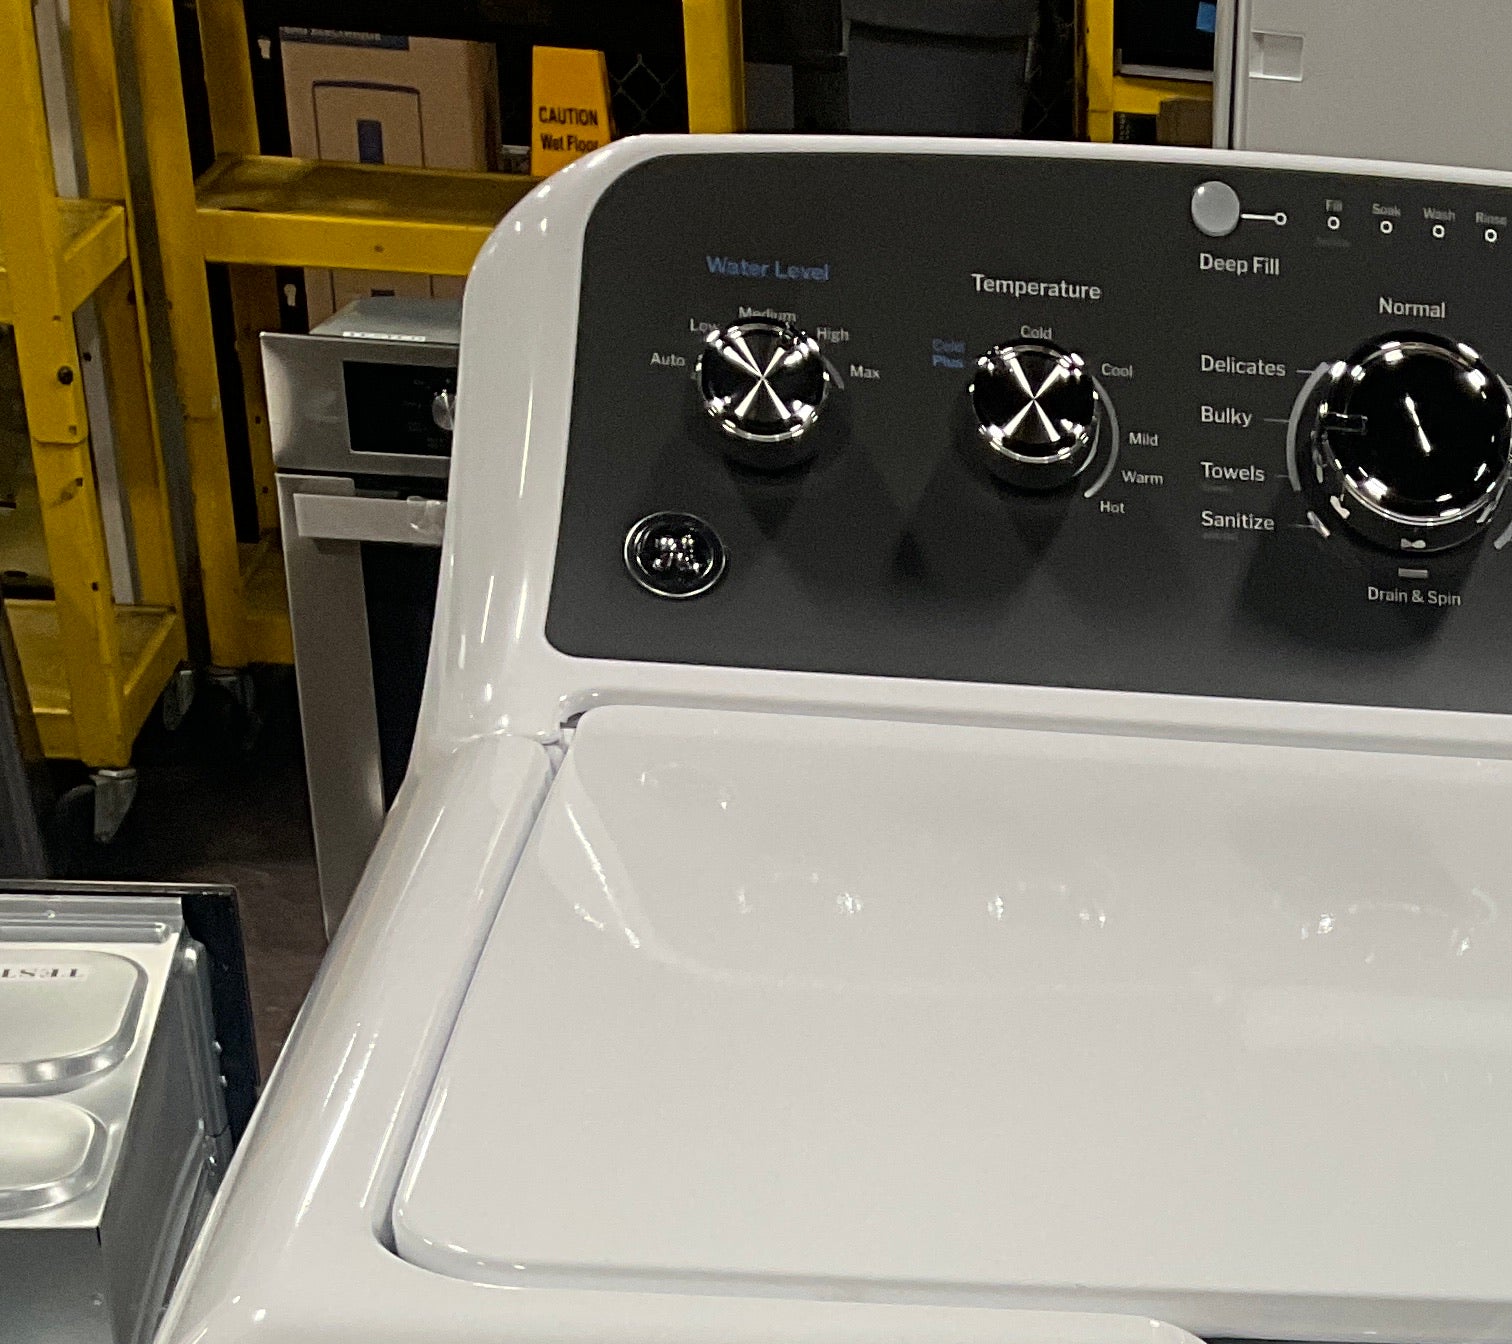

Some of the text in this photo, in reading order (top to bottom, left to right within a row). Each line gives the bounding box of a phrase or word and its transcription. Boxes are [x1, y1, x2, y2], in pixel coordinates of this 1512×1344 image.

[538, 106, 599, 126] CAUTION
[540, 133, 599, 152] Wet Floor
[1371, 203, 1401, 217] Soak
[1423, 207, 1456, 222] Wash
[706, 255, 831, 282] Water Level
[1199, 252, 1280, 276] Deep Fill
[971, 272, 1102, 300] Temperature
[738, 306, 797, 323] Medium
[1378, 296, 1447, 319] Normal
[816, 326, 850, 343] High
[1020, 324, 1053, 340] Cold
[649, 352, 686, 367] Auto
[1200, 353, 1287, 377] Delicates
[849, 363, 881, 380] Max
[1101, 362, 1133, 378] Cool
[1200, 405, 1252, 428] Bulky
[1128, 431, 1159, 447] Mild
[1121, 469, 1164, 486] Warm
[1200, 460, 1266, 482] Towels
[1100, 500, 1126, 514] Hot
[1201, 509, 1275, 531] Sanitize
[1367, 586, 1462, 607] Drain & Spin
